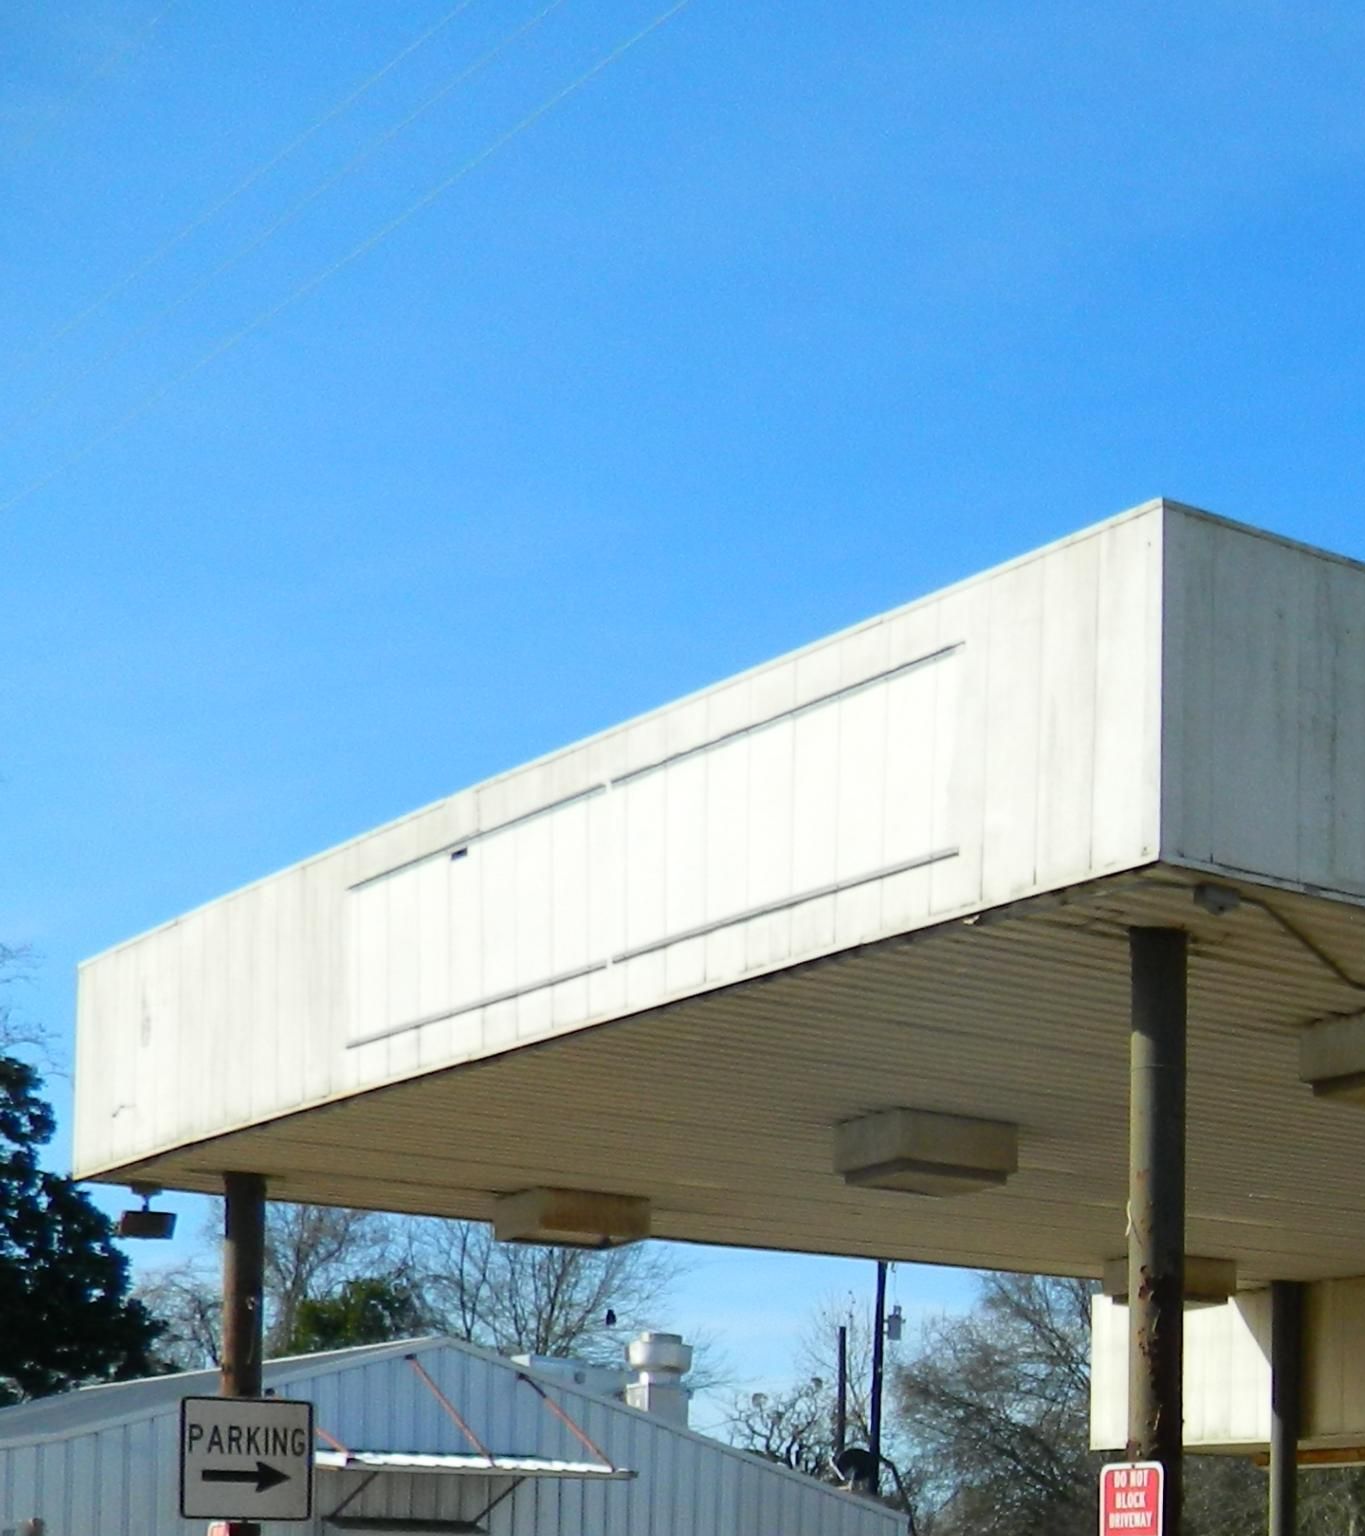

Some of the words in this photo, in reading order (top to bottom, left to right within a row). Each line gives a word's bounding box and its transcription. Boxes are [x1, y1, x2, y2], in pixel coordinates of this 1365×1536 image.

[188, 1424, 306, 1457] PARKING
[1113, 1470, 1128, 1489] DO
[1129, 1469, 1149, 1488] NOT
[1115, 1491, 1146, 1509] BLOCK
[1108, 1511, 1153, 1529] DRIVEWAY
